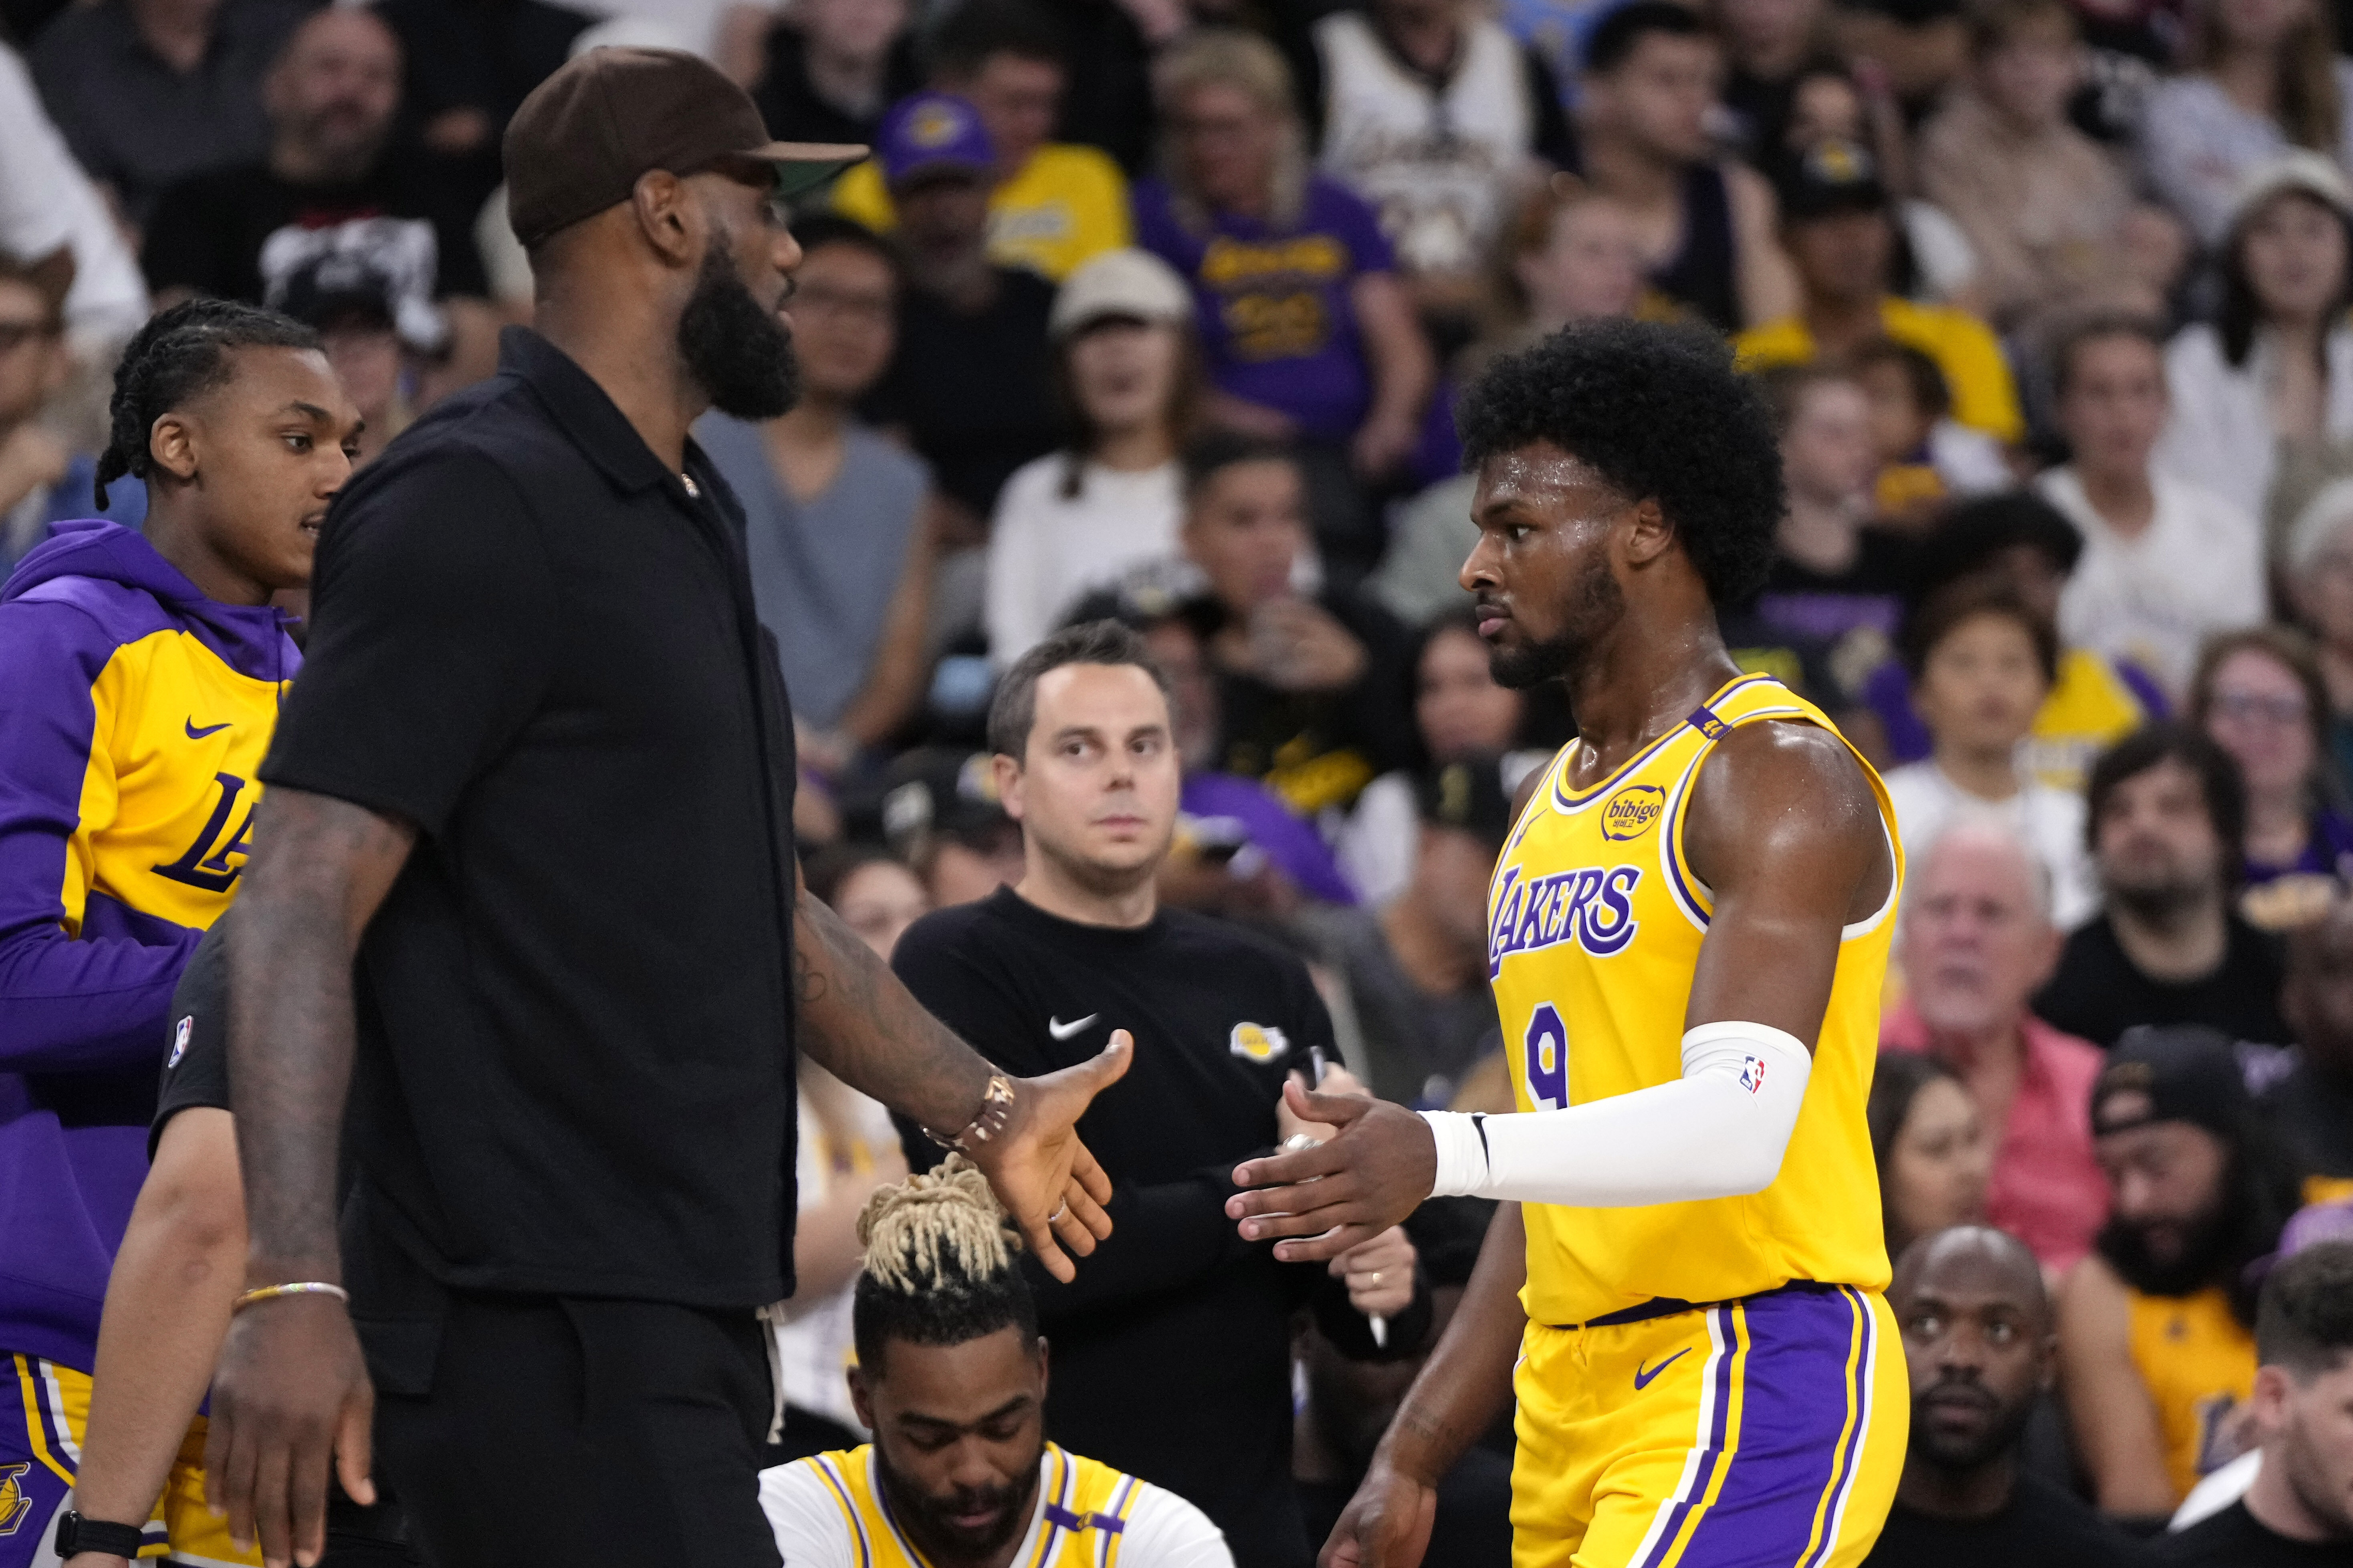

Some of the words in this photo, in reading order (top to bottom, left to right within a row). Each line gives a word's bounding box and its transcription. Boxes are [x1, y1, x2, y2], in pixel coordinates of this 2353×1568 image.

[1703, 720, 1723, 737] 44
[1608, 799, 1660, 824] bibigo
[1612, 819, 1635, 828] 비비고
[1489, 864, 1643, 982] LAKERS
[1524, 1001, 1569, 1110] 9
